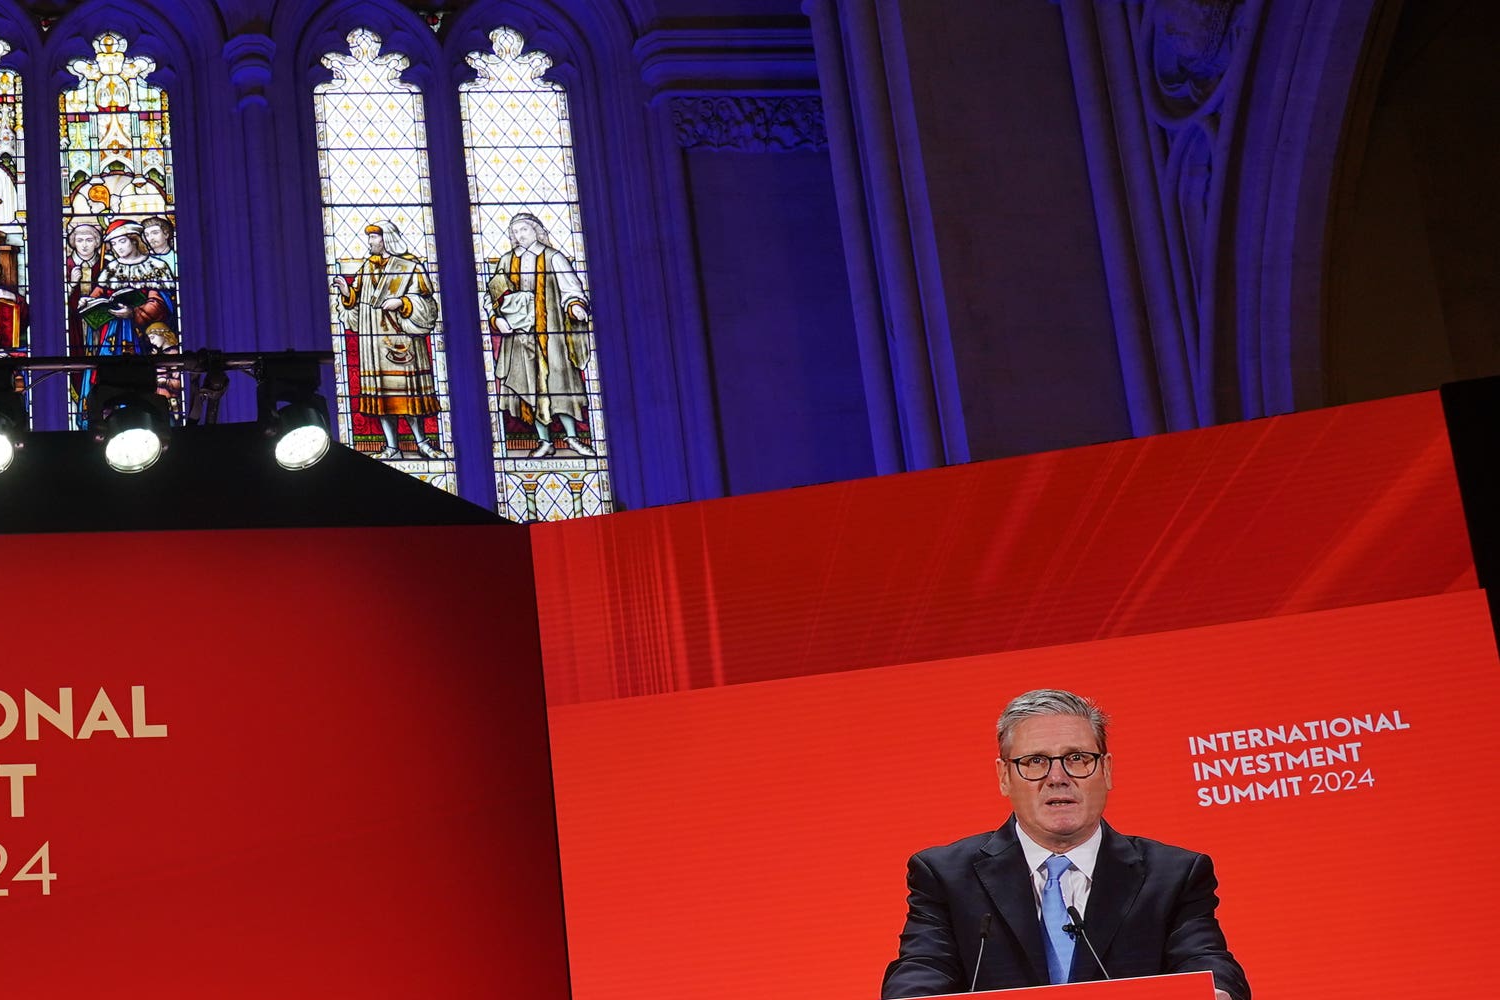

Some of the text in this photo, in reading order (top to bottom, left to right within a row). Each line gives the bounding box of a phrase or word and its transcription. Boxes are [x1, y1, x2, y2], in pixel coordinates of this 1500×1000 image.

[516, 460, 585, 469] COVERDALE
[1187, 710, 1411, 757] INTERNATIONAL
[1192, 741, 1362, 782] INVESTMENT
[1197, 768, 1376, 808] SUMMIT 2024
